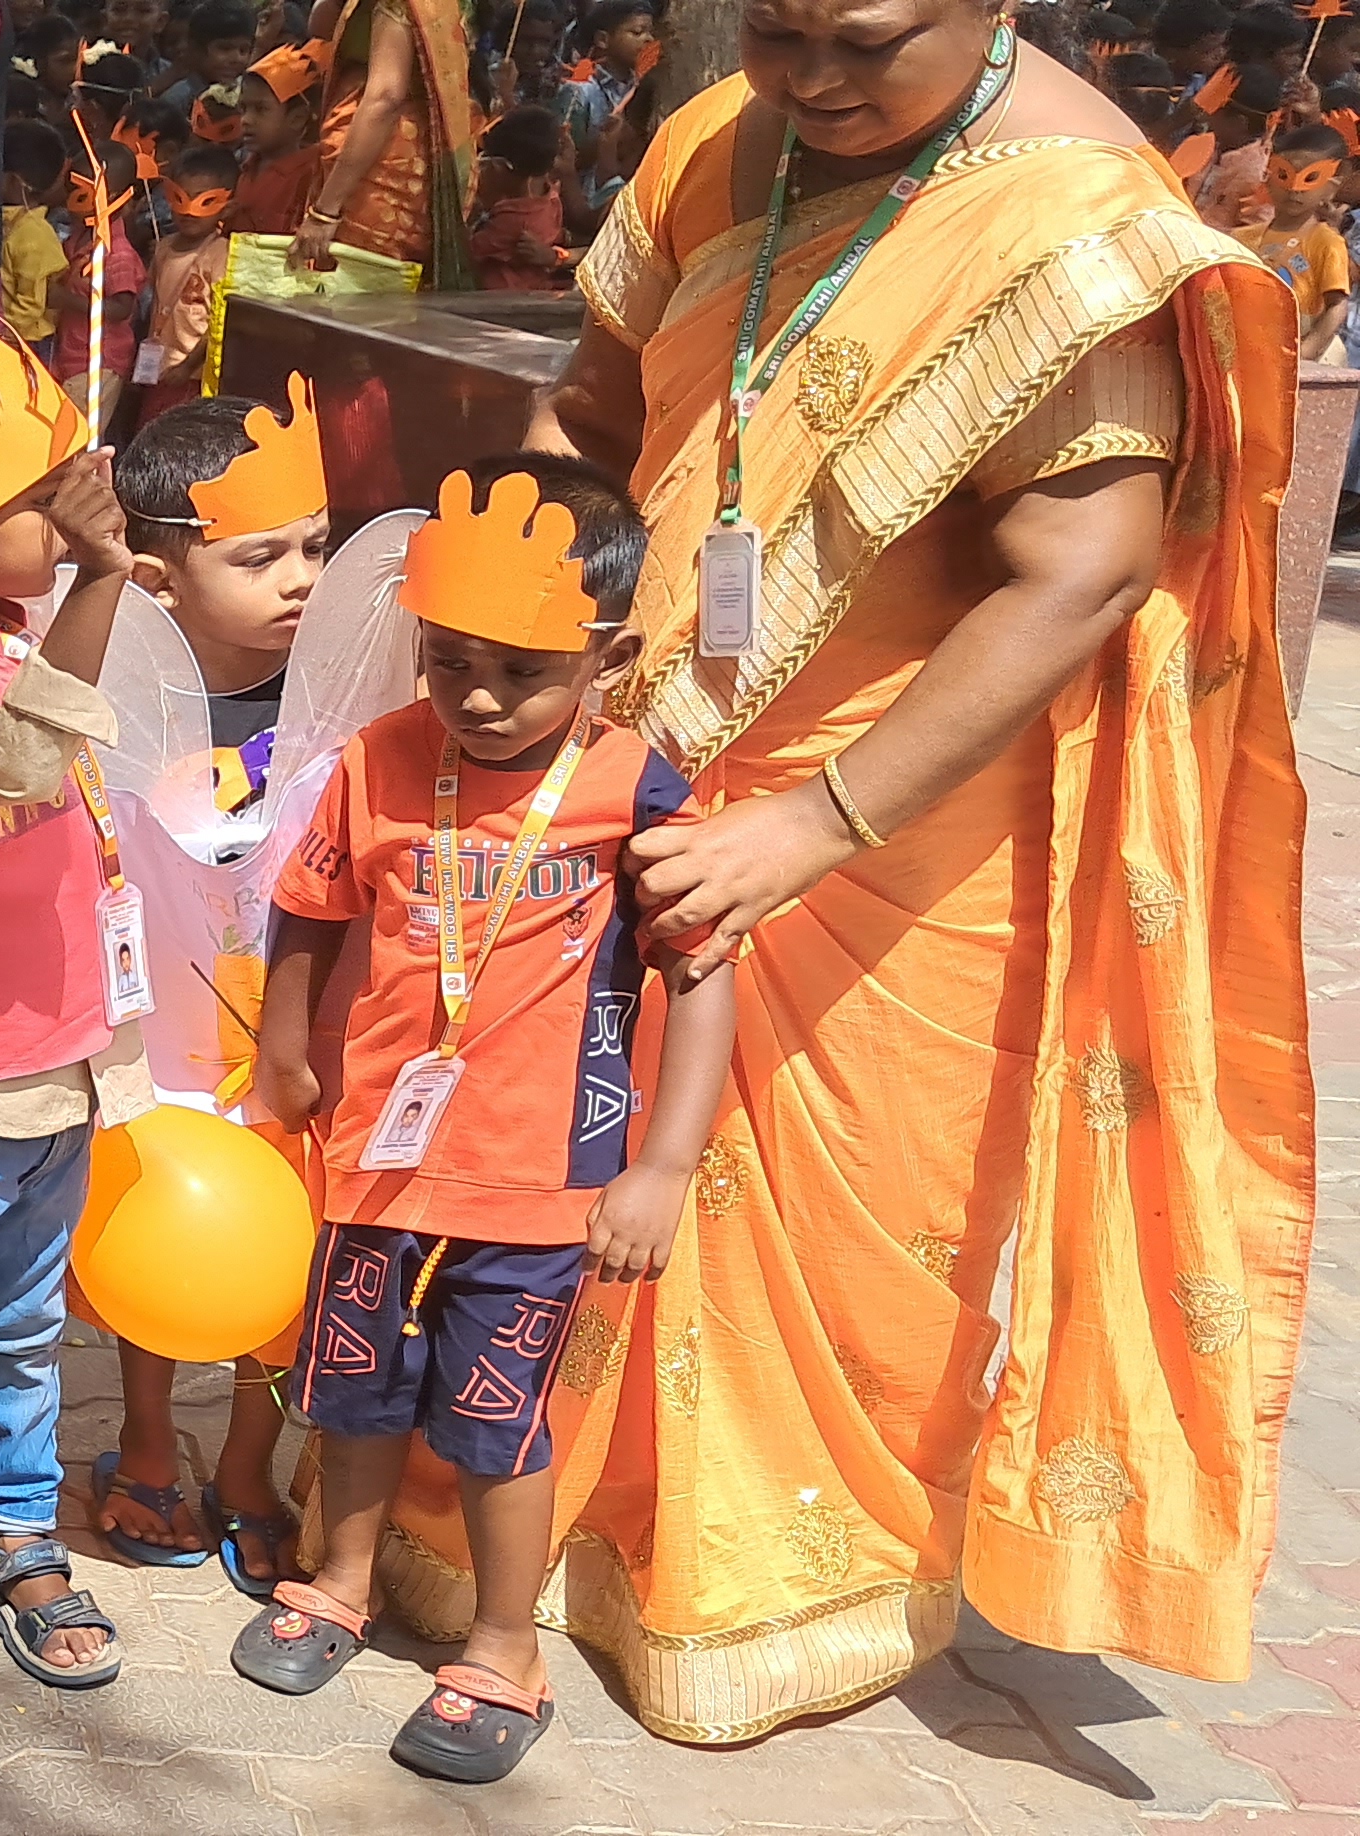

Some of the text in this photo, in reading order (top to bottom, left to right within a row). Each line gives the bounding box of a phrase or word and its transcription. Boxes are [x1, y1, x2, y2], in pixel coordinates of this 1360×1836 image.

[736, 207, 779, 362] SRI GOMATHI AMBAL
[763, 236, 873, 380] SRI GOMATHI AMBAL
[89, 784, 106, 808] SRI
[550, 762, 570, 786] SRI
[438, 816, 459, 964] SRI GOMATHI AMBAL
[482, 883, 513, 946] GOMATHI
[507, 832, 537, 880] AMBAL
